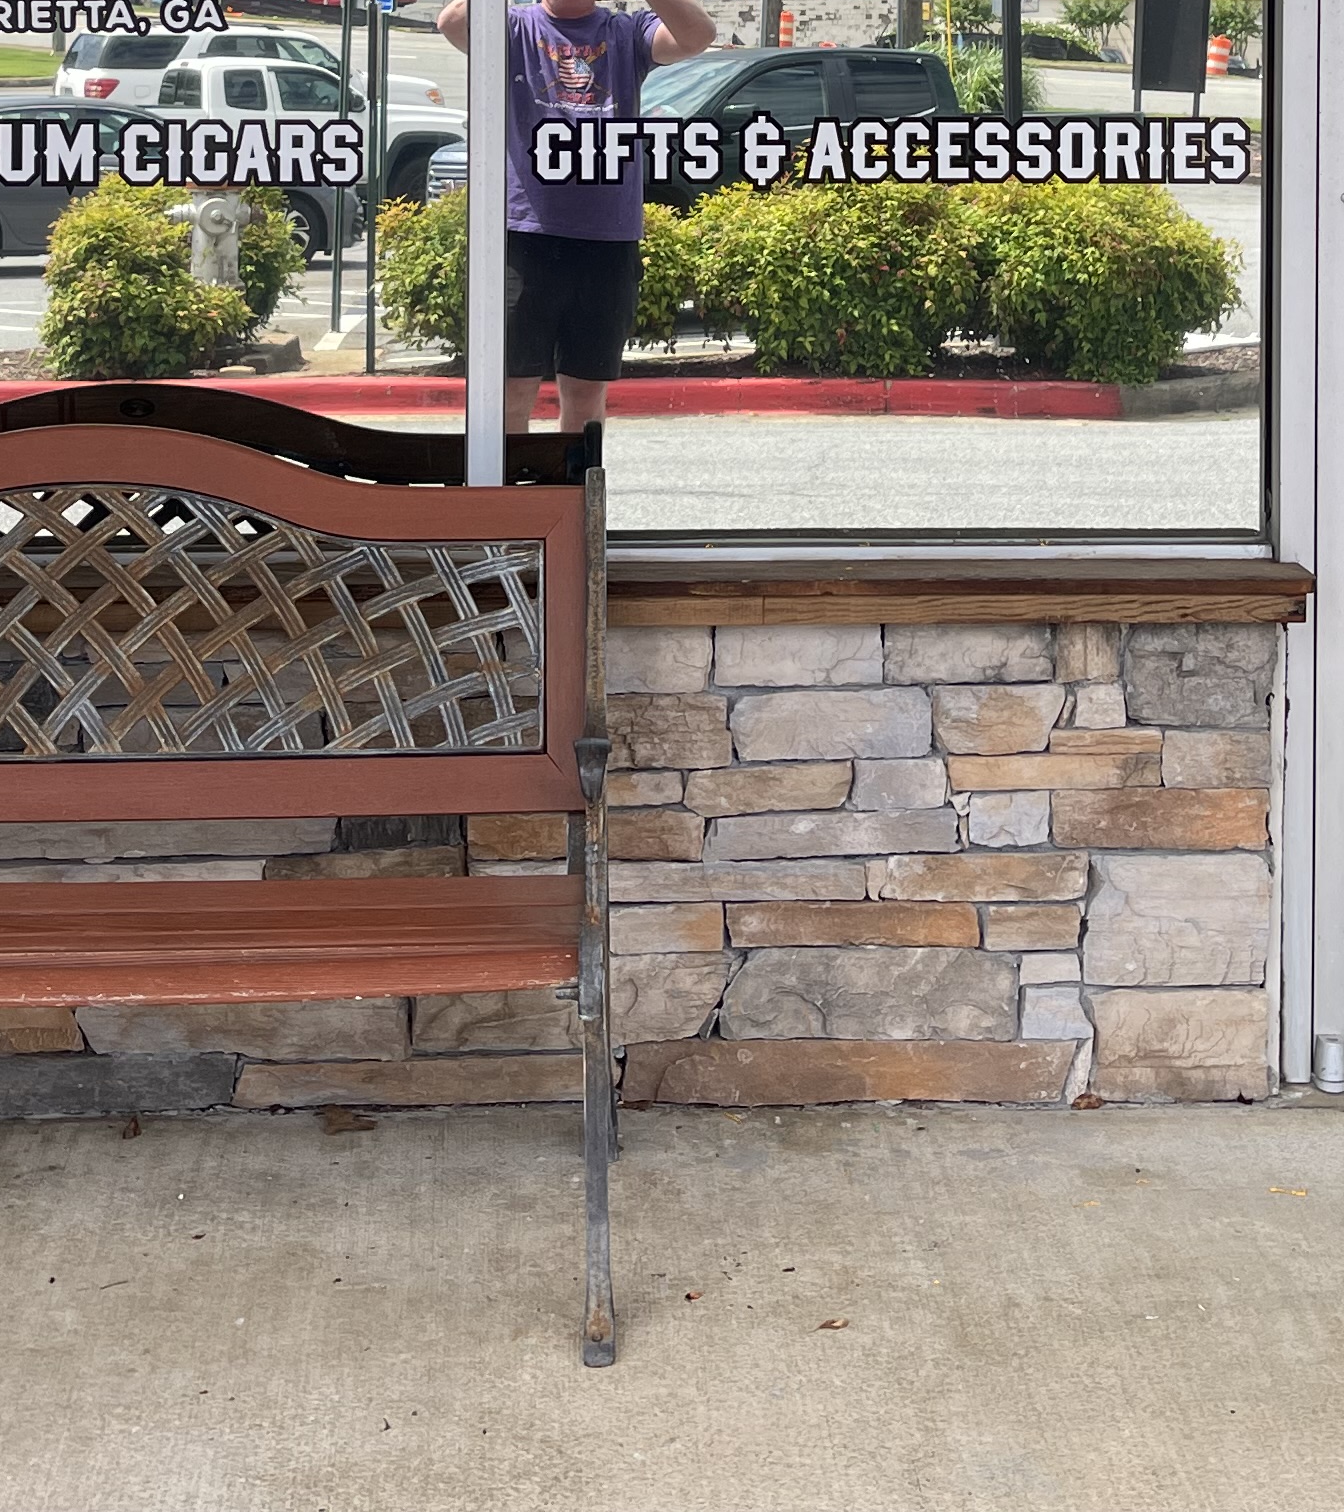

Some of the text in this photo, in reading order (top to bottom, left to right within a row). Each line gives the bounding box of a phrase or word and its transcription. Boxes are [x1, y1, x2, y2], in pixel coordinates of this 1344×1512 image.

[118, 119, 364, 188] CIGARS
[530, 111, 1251, 190] GIFTS & ACCESSORIES
